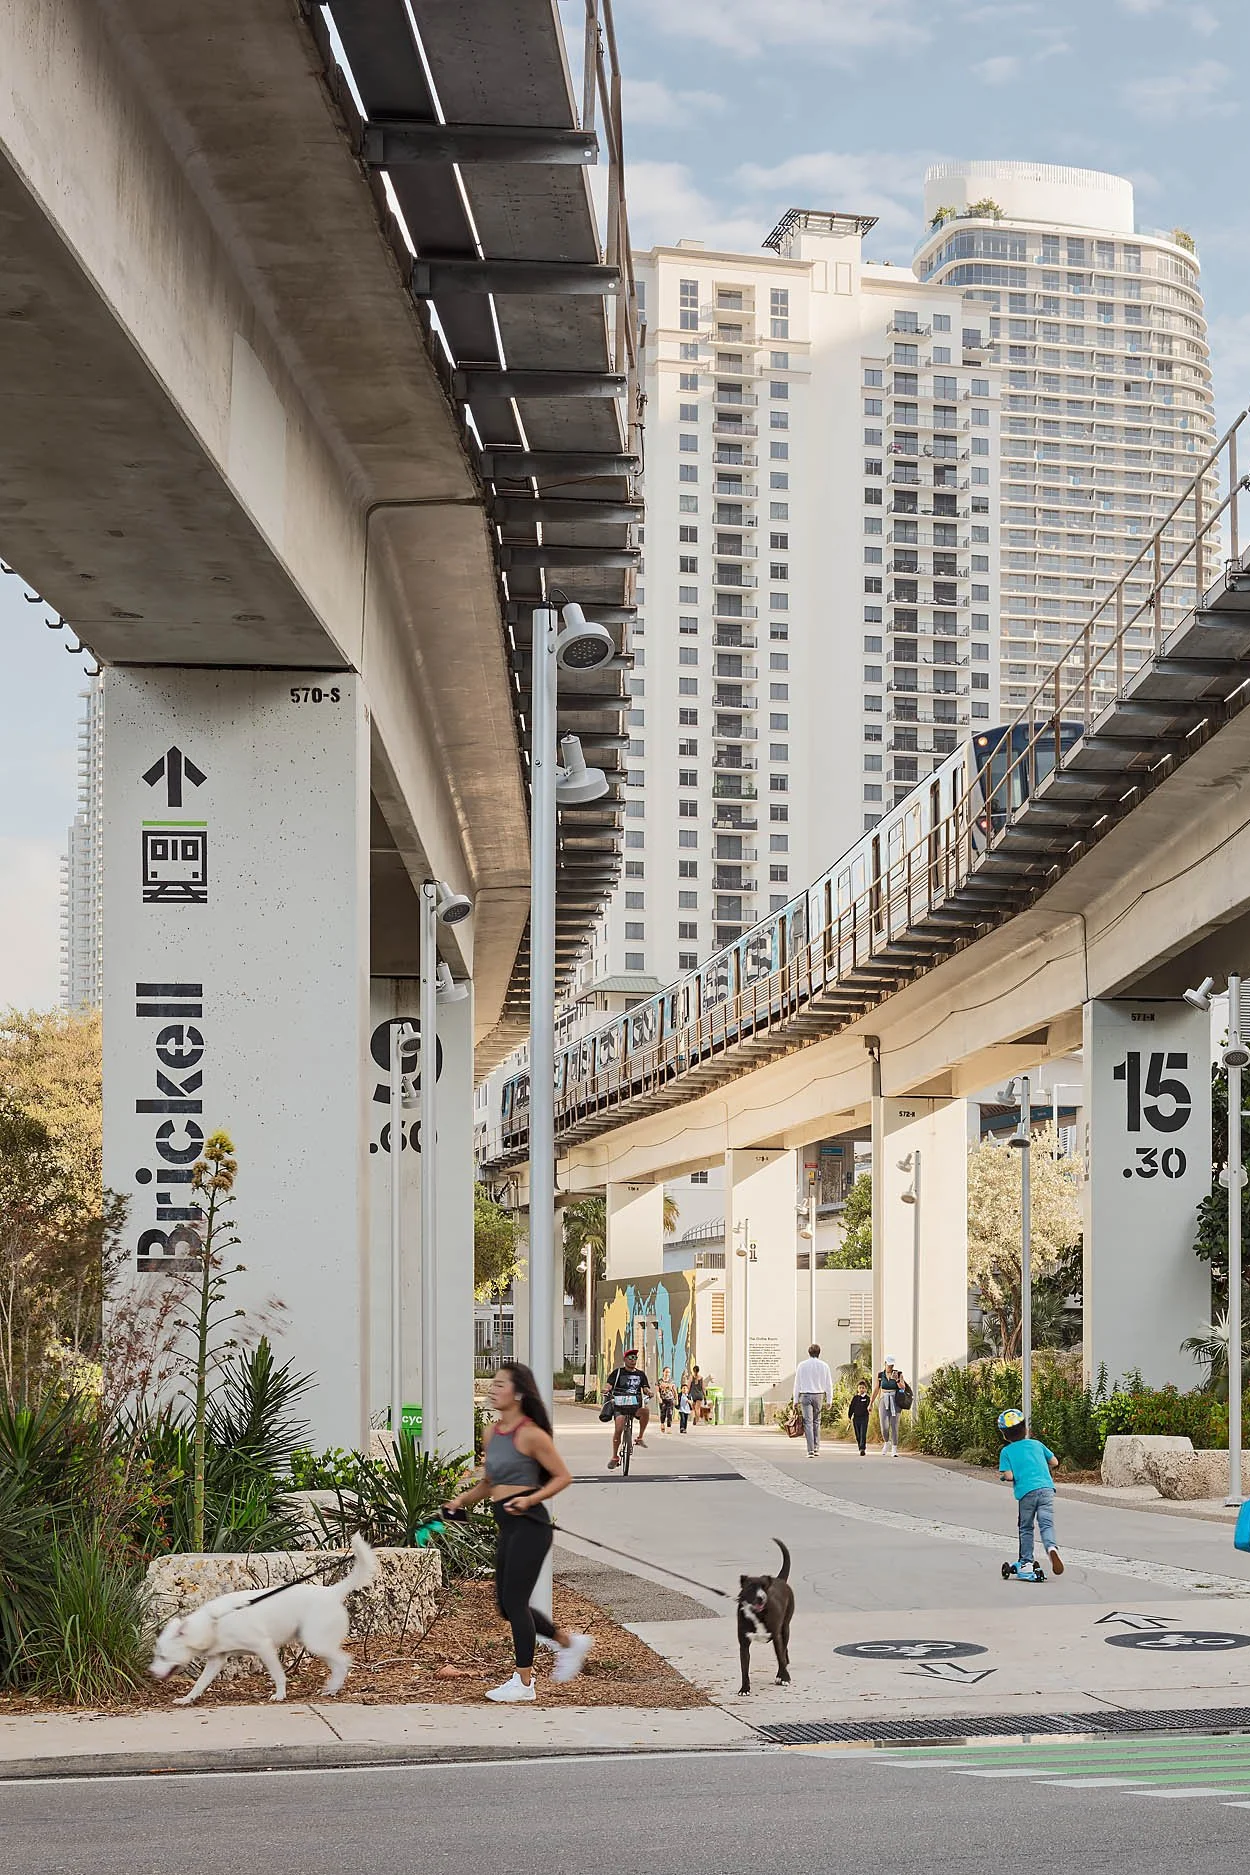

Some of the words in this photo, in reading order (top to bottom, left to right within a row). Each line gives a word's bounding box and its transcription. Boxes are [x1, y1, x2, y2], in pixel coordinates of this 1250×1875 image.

[290, 687, 341, 703] 570-S
[1113, 1051, 1192, 1133] 15
[135, 982, 205, 1273] Brickell
[1122, 1147, 1187, 1179] .30
